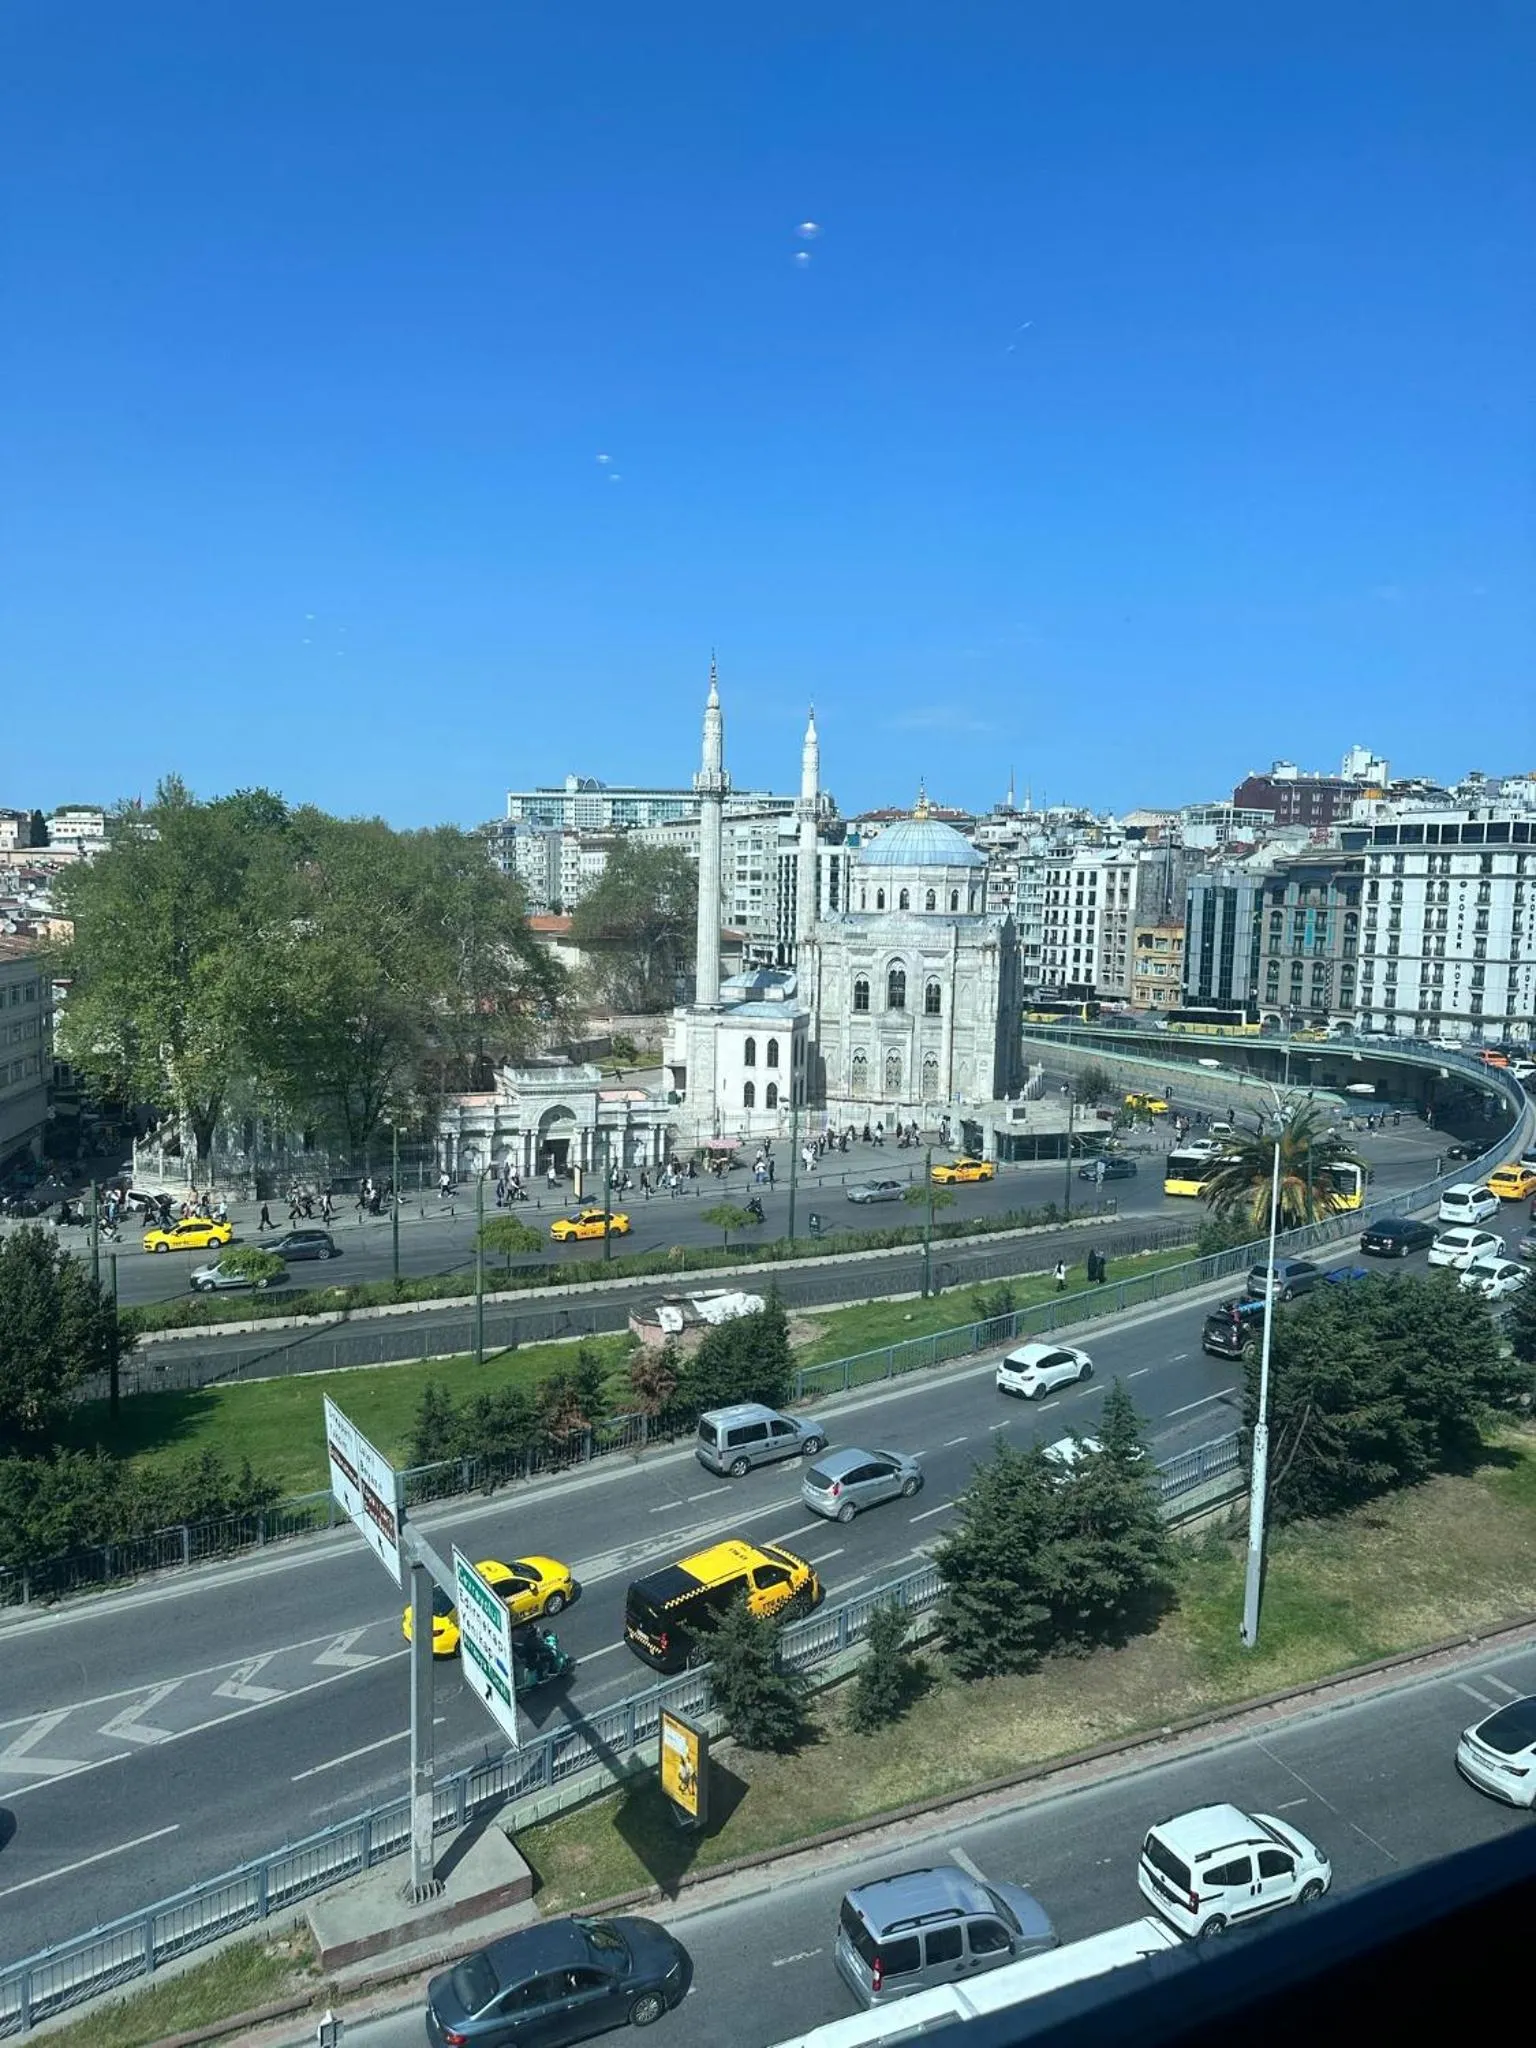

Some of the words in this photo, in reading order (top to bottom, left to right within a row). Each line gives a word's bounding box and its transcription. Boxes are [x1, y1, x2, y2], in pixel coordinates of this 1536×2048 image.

[1456, 894, 1466, 950] CORNER
[1527, 894, 1536, 950] CORNER
[1453, 963, 1461, 1008] HOTEL
[1523, 966, 1531, 1010] HOTEL
